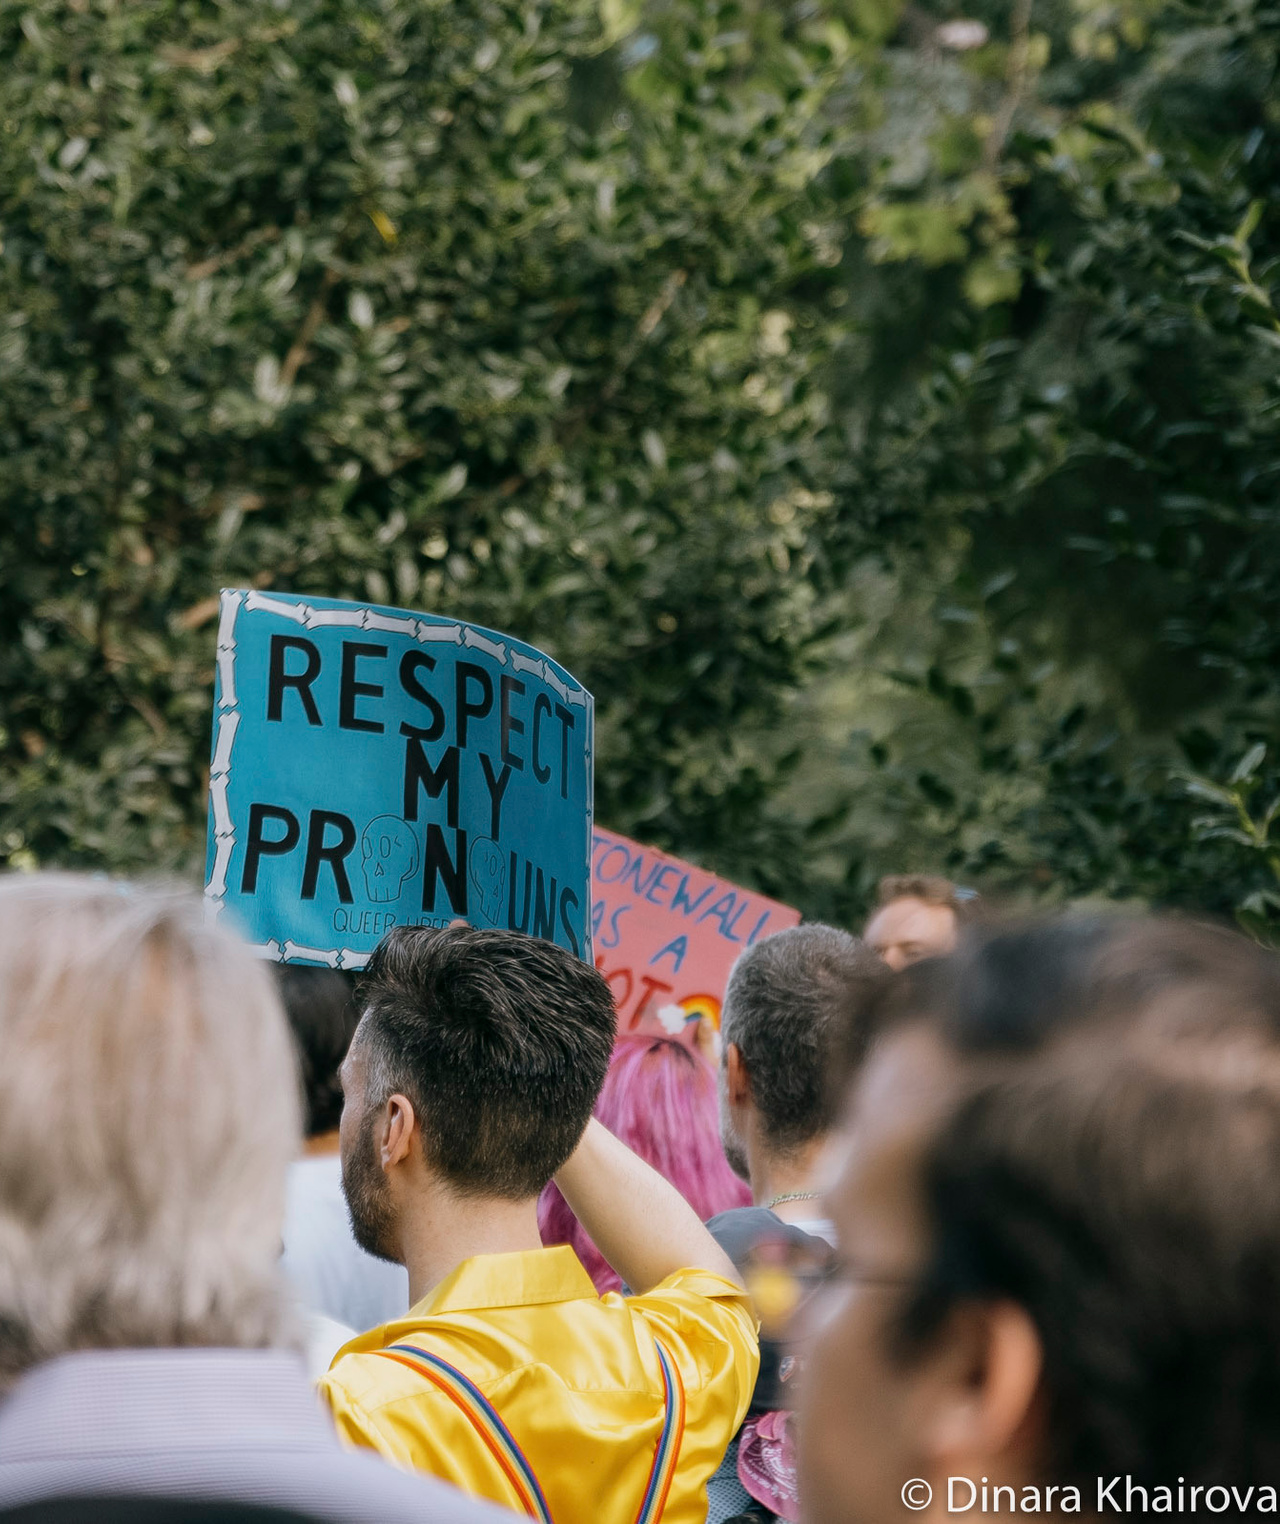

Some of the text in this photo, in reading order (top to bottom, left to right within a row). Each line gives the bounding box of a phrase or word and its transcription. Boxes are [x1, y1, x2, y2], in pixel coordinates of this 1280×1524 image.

[267, 634, 575, 800] RESPECT
[404, 737, 512, 842] MY
[333, 907, 397, 935] QUEER
[593, 835, 771, 947] TONEWALL
[593, 899, 688, 974] AS A
